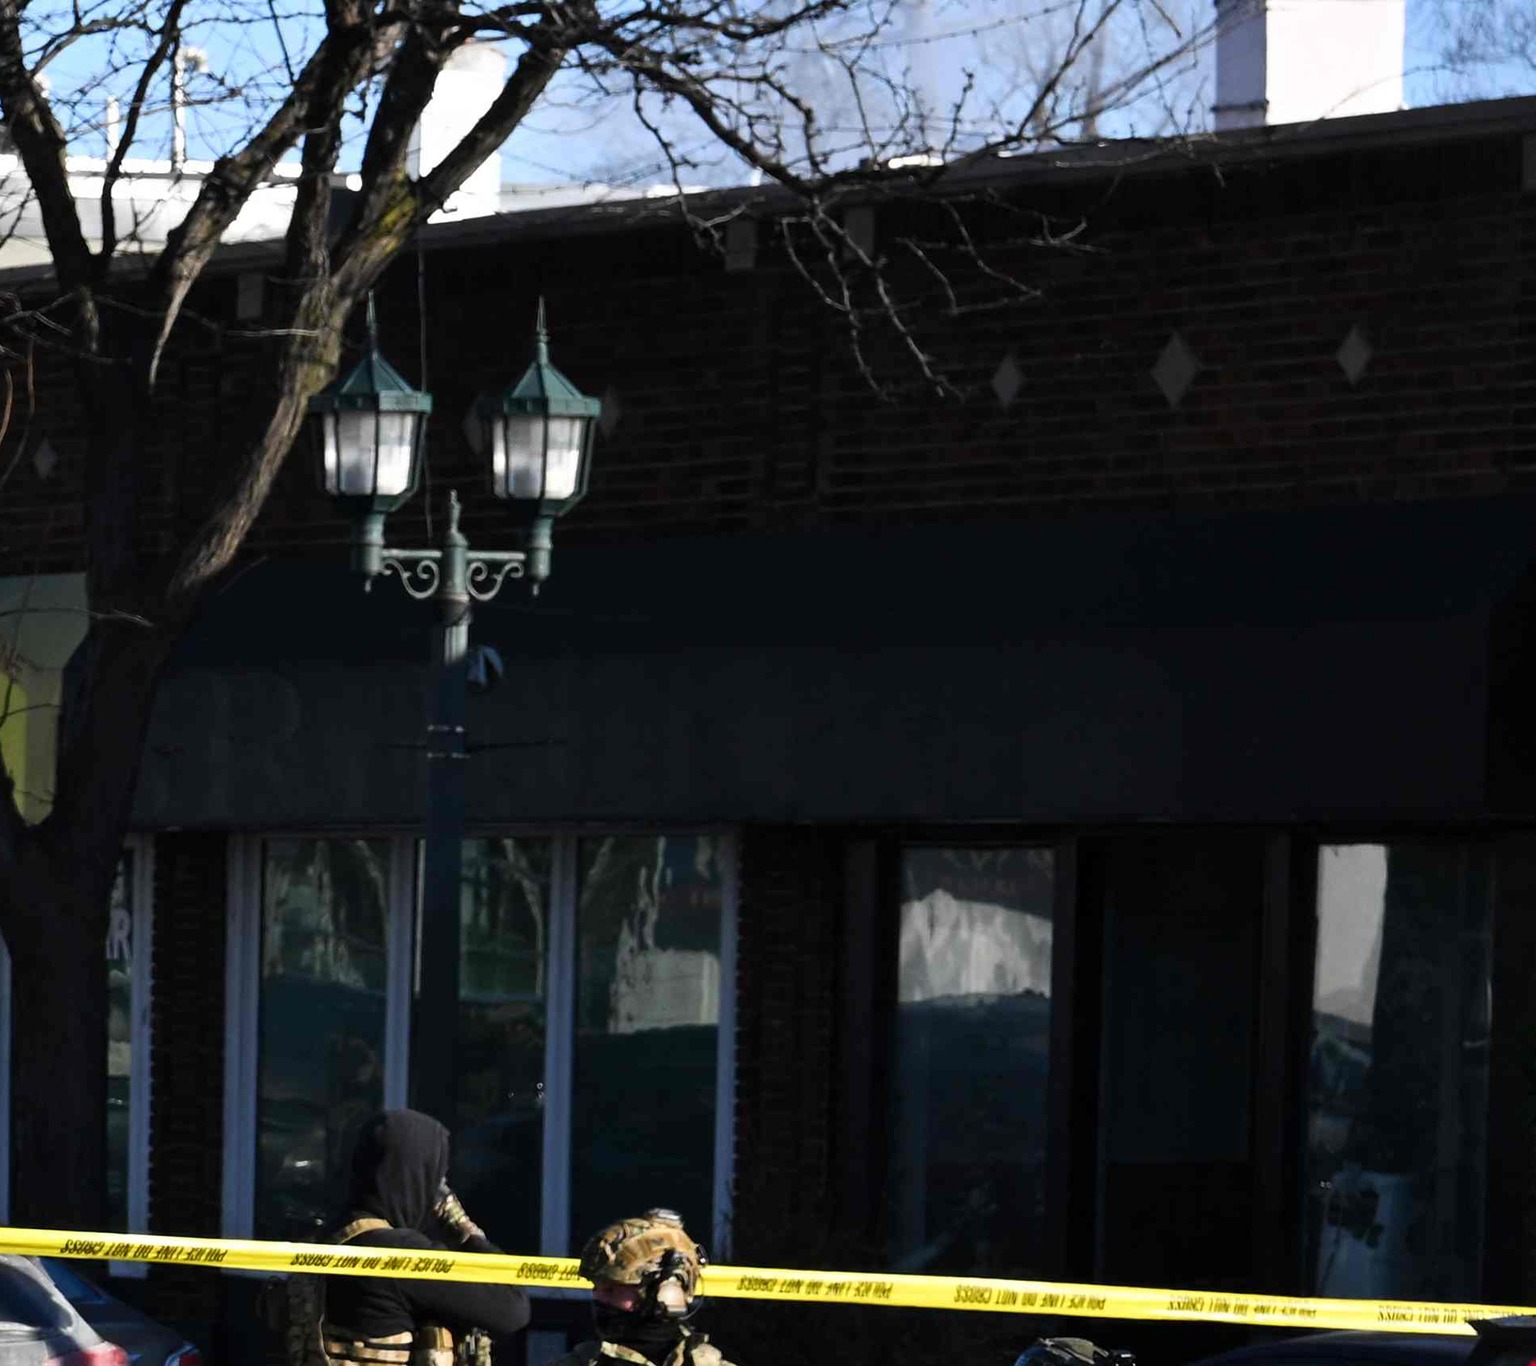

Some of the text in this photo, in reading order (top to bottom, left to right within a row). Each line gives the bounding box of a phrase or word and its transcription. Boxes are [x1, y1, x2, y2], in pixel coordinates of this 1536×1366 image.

[60, 1239, 228, 1262] POLICE LINE DO NOT CROSS
[290, 1253, 455, 1273] POLICE LINE DO NOT CROSS
[516, 1262, 558, 1280] CROSS
